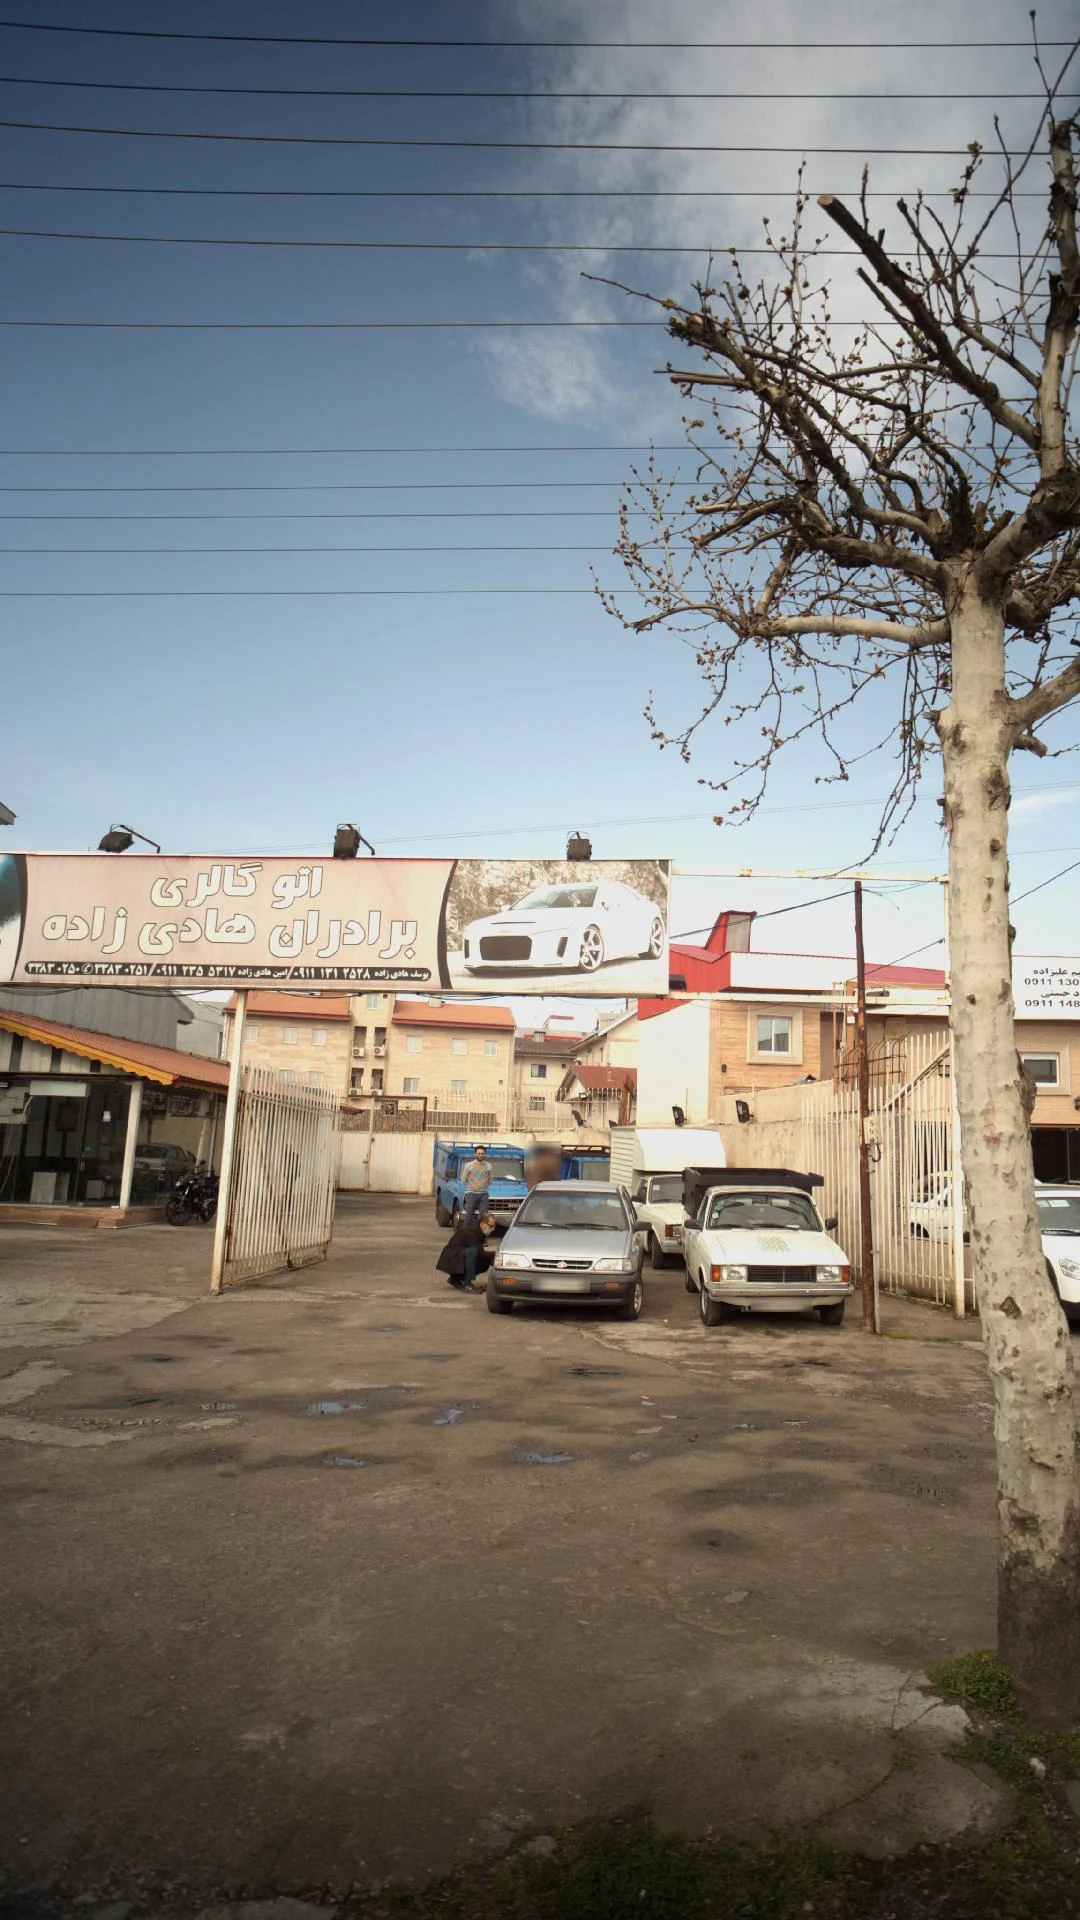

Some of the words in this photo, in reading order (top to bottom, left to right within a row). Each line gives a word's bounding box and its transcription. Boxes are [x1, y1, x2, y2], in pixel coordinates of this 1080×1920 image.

[149, 862, 263, 908] گالری
[271, 865, 324, 910] اتو
[41, 906, 129, 955] زاده
[137, 908, 257, 956] هادی
[268, 909, 419, 959] برادران
[156, 965, 177, 976] ۰۹۱۱
[237, 967, 253, 978] زاده
[253, 967, 272, 978] هادی
[294, 967, 315, 979] ۰۹۱۱
[320, 967, 338, 979] ۱۳۱
[374, 969, 390, 979] زاده
[390, 969, 409, 979] هادی
[1024, 978, 1052, 986] 0911
[1025, 999, 1053, 1007] 0911
